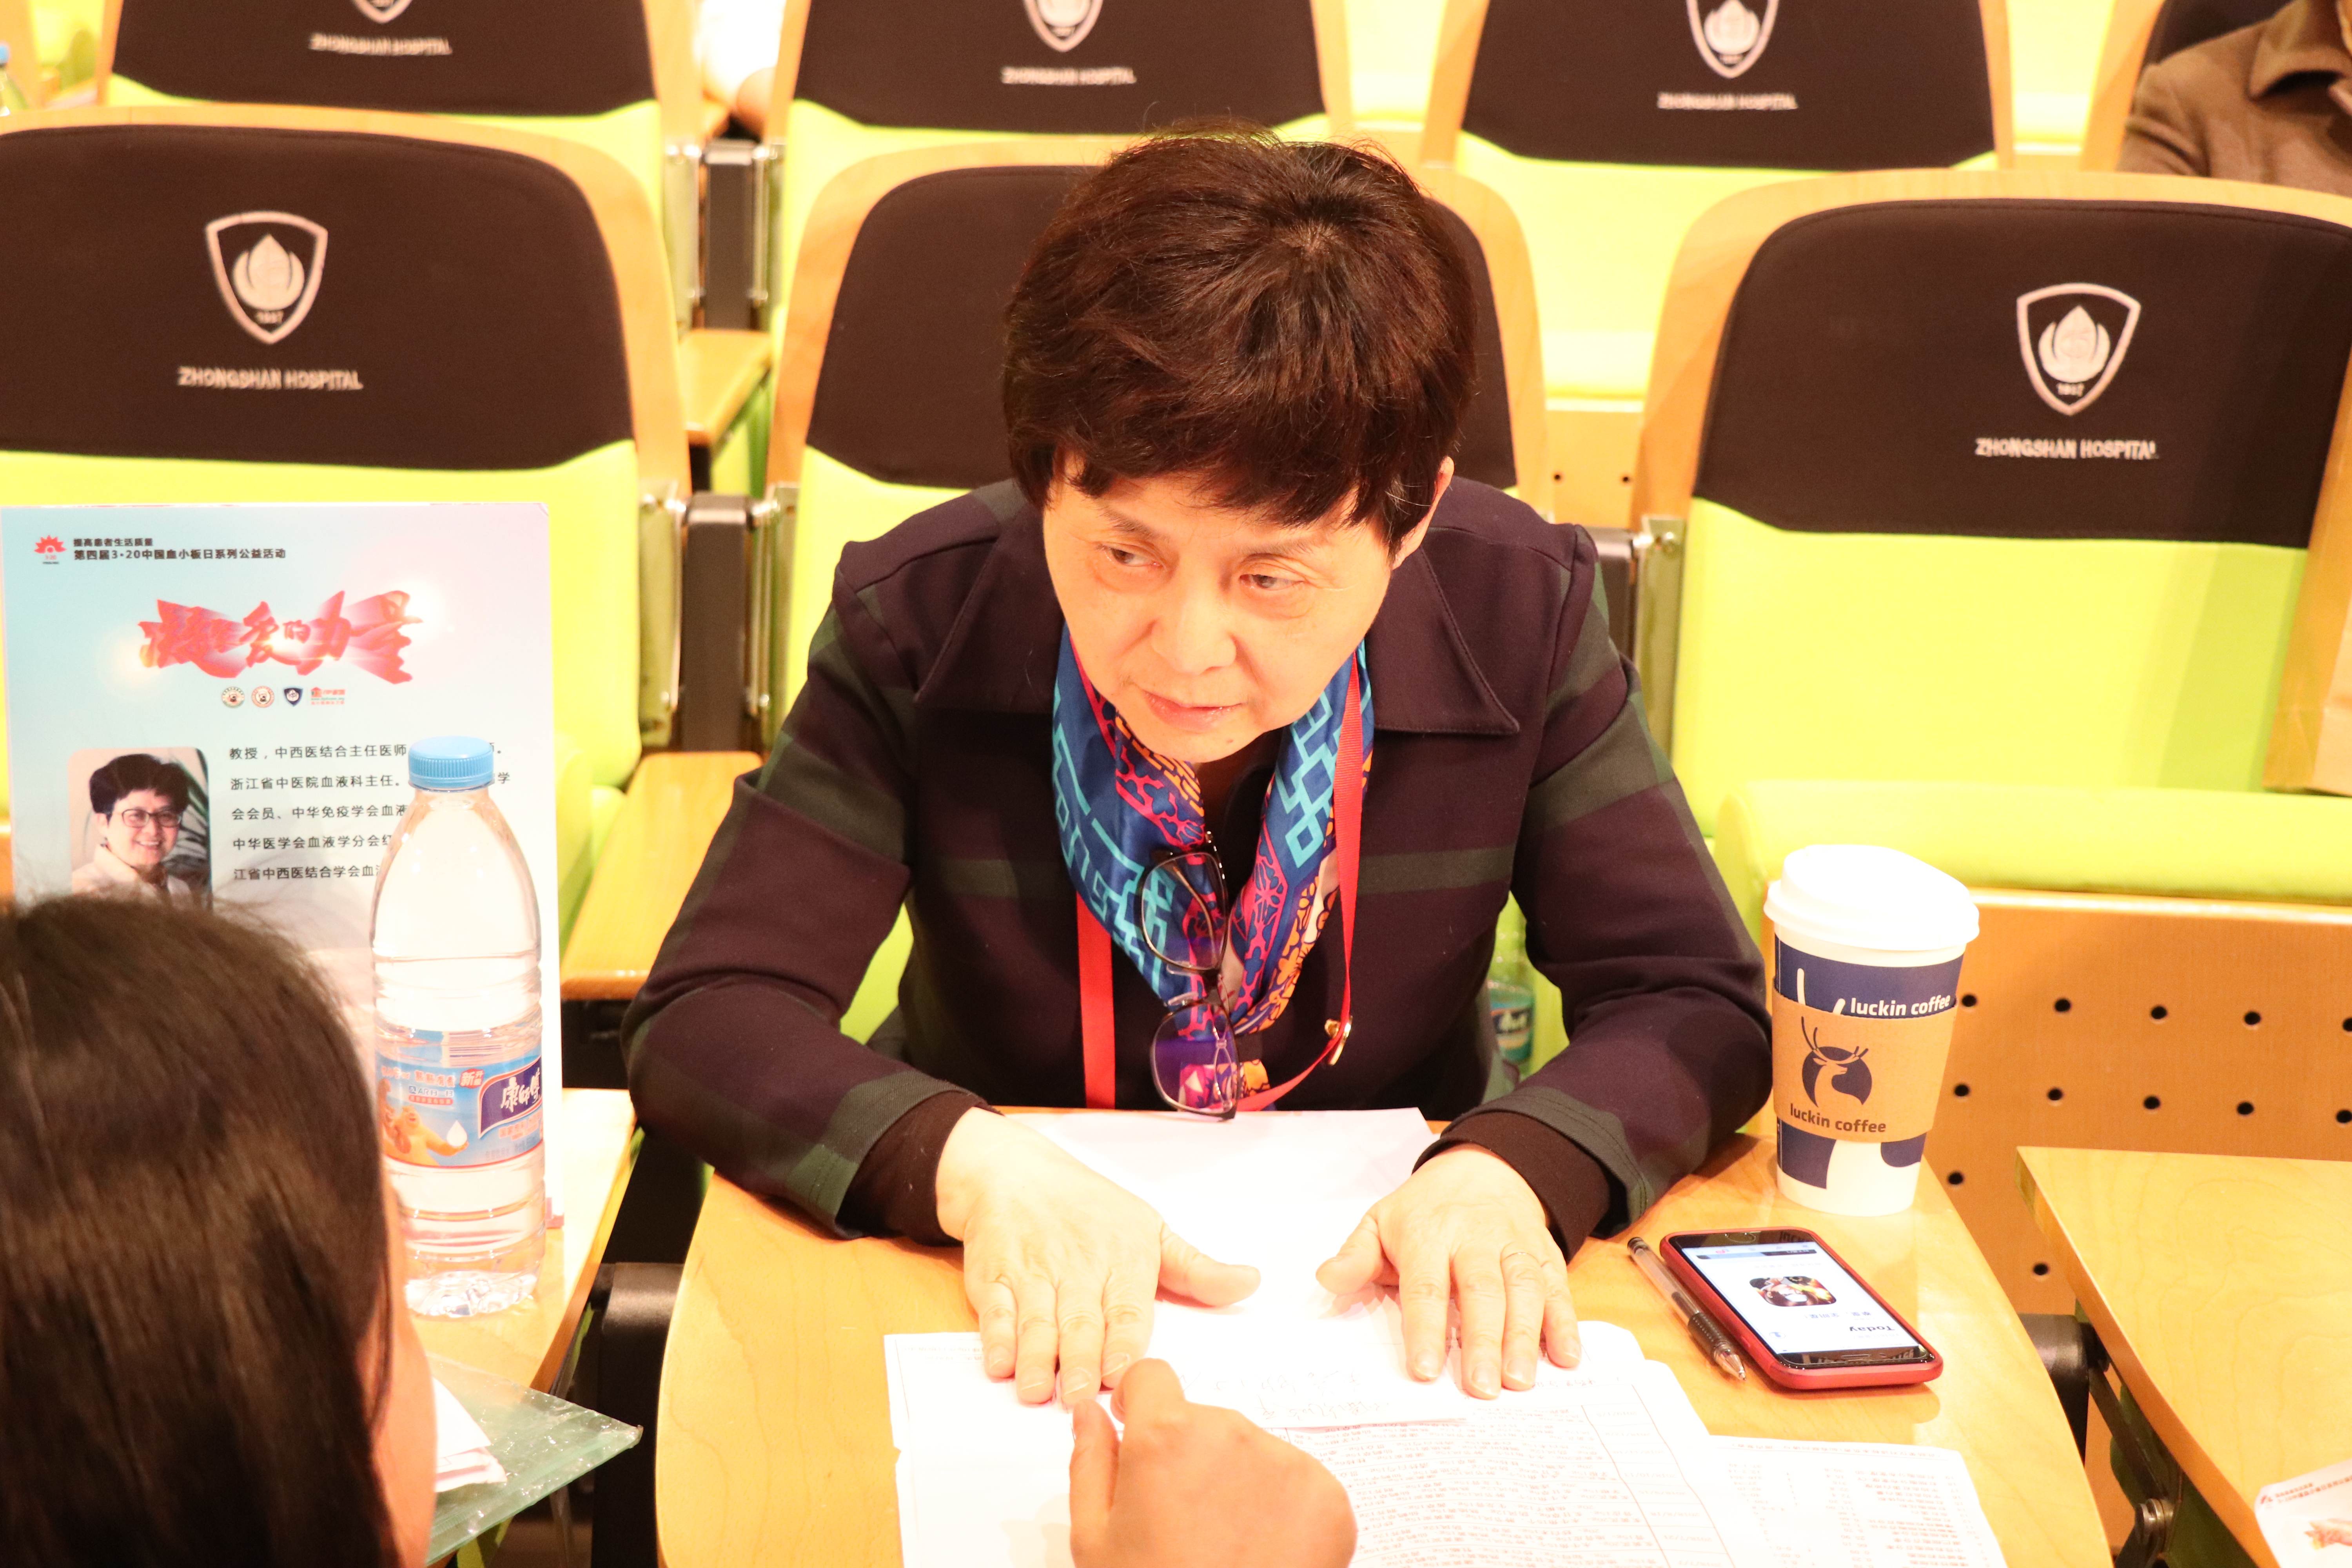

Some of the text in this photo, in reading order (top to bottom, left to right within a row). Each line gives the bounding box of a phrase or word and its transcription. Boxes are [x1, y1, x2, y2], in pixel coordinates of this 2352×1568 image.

[309, 32, 453, 55] ZHONGSHAN HOSPITAL
[1001, 66, 1137, 85] ZHONGSHAN HOSPITAL
[1657, 91, 1798, 110] ZHONGSHAN HOSPITAL
[177, 366, 364, 390] ZHONGSHAN HOSPITAL
[1975, 437, 2077, 459] ZHONGSHAN
[73, 538, 153, 547] 提高患者生活质量
[1850, 995, 1951, 1016] luckin coffee
[1790, 1103, 1886, 1133] luckin coffee
